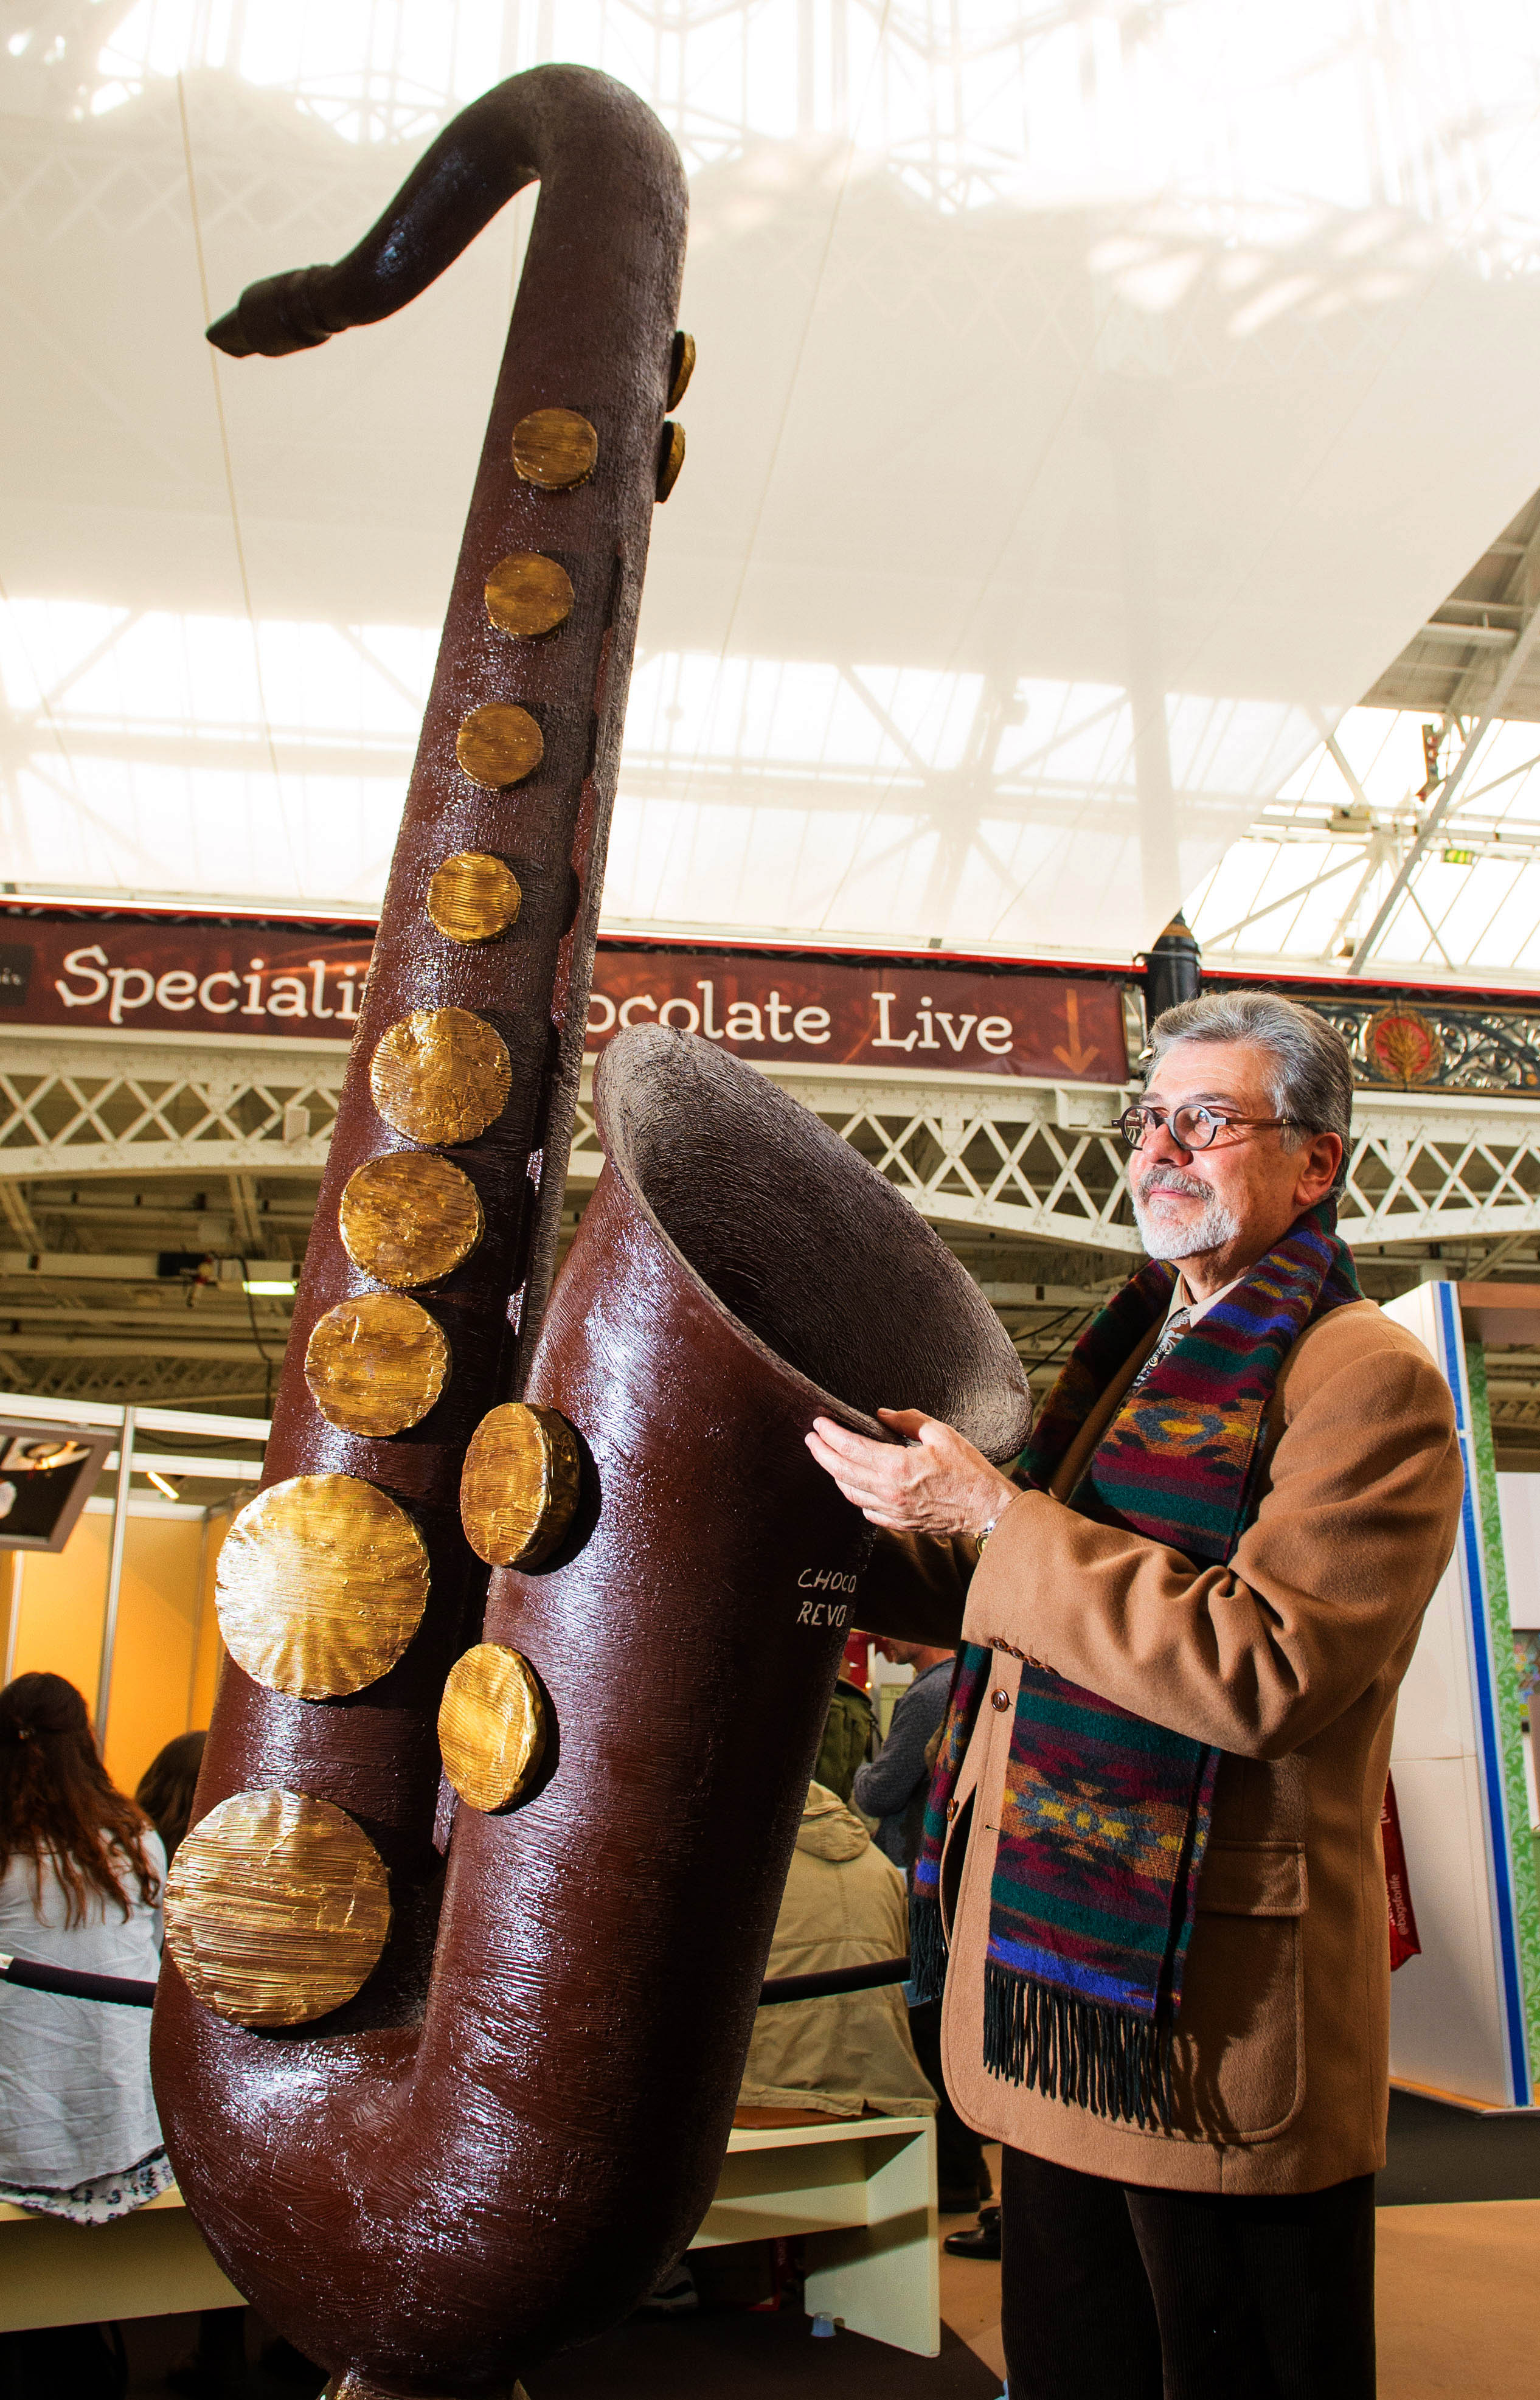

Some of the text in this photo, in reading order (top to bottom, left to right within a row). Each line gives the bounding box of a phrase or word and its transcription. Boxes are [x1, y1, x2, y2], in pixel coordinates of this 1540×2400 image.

[55, 945, 367, 1024] Speciali
[871, 991, 1014, 1055] Live
[797, 1568, 857, 1593] CHOCO
[796, 1601, 847, 1628] REVO
[1389, 1873, 1409, 1935] @bagsforlife
